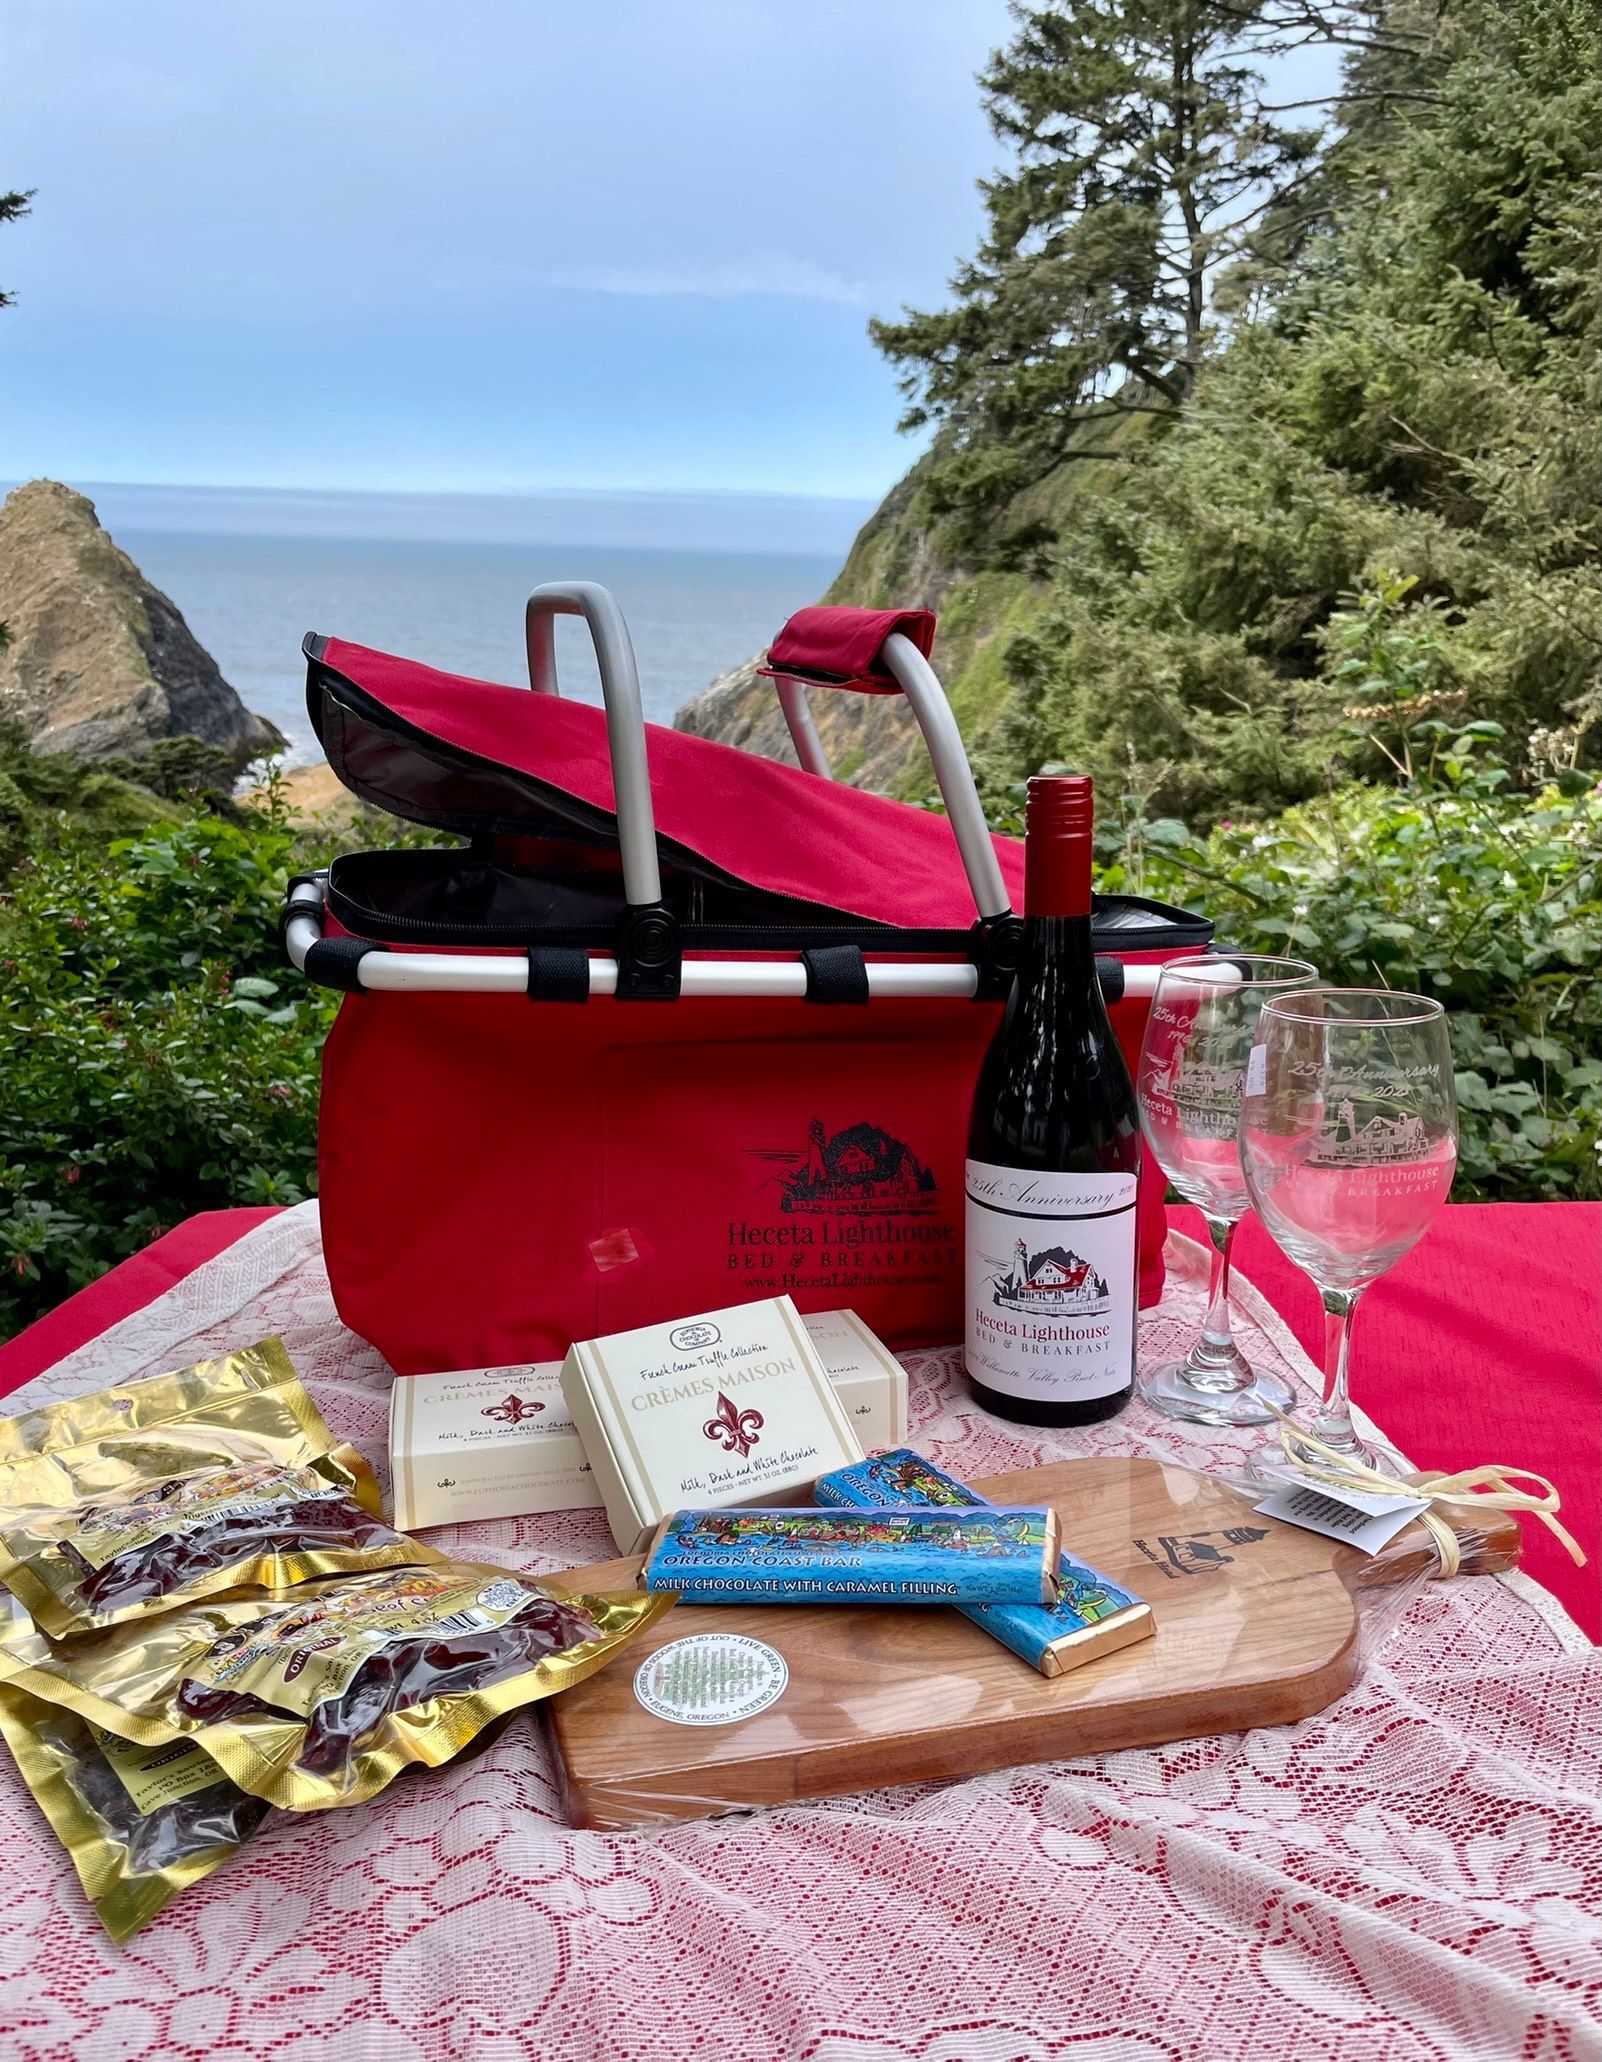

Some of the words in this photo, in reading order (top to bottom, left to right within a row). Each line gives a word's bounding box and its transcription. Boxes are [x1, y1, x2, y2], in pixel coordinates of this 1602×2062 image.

[1141, 1093, 1173, 1116] Heceta
[1176, 1107, 1236, 1126] Lightho
[1350, 1166, 1440, 1184] Lighthouse
[1000, 1180, 1114, 1209] Anniversary
[1348, 1180, 1437, 1197] BREAKFAST
[728, 1222, 814, 1246] Heceta
[823, 1219, 956, 1249] Lighthouse
[727, 1252, 775, 1269] BED
[791, 1253, 803, 1268] &
[821, 1249, 958, 1268] BREAKFAST
[975, 1308, 1017, 1336] Heceta
[1022, 1324, 1110, 1342] Lighthouse
[679, 1331, 713, 1344] CHOCOLATE
[684, 1338, 711, 1348] COMPANY
[975, 1327, 996, 1344] BED
[1003, 1339, 1012, 1349] &
[1021, 1341, 1110, 1356] BREAKFAST
[639, 1366, 670, 1381] French
[671, 1358, 698, 1375] Cream
[698, 1350, 730, 1369] Truffle
[729, 1344, 768, 1361] Collection
[827, 1365, 859, 1373] hocolate
[977, 1353, 1020, 1378] Willamette
[1027, 1367, 1060, 1385] Valley
[1063, 1370, 1096, 1384] Pinot
[504, 1376, 533, 1385] Truffle
[514, 1384, 561, 1394] MAIS
[631, 1381, 716, 1412] CRÈMES
[718, 1358, 796, 1390] MAISON
[439, 1432, 464, 1441] Milk,
[470, 1428, 495, 1437] Dark
[498, 1426, 516, 1434] and
[518, 1423, 544, 1432] White
[547, 1420, 575, 1429] Chocol
[680, 1477, 706, 1494] Milk,
[708, 1469, 734, 1485] Dark
[735, 1461, 753, 1478] and
[753, 1454, 781, 1472] White
[780, 1446, 818, 1465] Chocolate
[713, 1484, 735, 1494] PIECES
[738, 1479, 753, 1488] NET
[821, 1482, 842, 1500] MILK
[842, 1473, 889, 1507] OREGON
[663, 1555, 746, 1567] OREGON
[752, 1555, 817, 1567] COAST
[820, 1556, 863, 1567] BAR
[654, 1578, 690, 1590] MILK
[694, 1578, 779, 1591] CHOCOLATE
[783, 1579, 822, 1592] WITH
[826, 1581, 897, 1593] CARAMEL
[900, 1582, 958, 1595] FILLING
[677, 1638, 694, 1648] THE
[738, 1638, 762, 1650] LIVE
[650, 1645, 677, 1664] WOODS
[761, 1649, 781, 1673] GREEN
[642, 1660, 651, 1671] OF
[640, 1670, 650, 1699] OREGON
[771, 1679, 780, 1690] BE
[740, 1690, 773, 1714] GREEN
[686, 1712, 730, 1720] OREGON
[141, 1794, 160, 1809] Cave
[205, 1769, 218, 1777] OR
